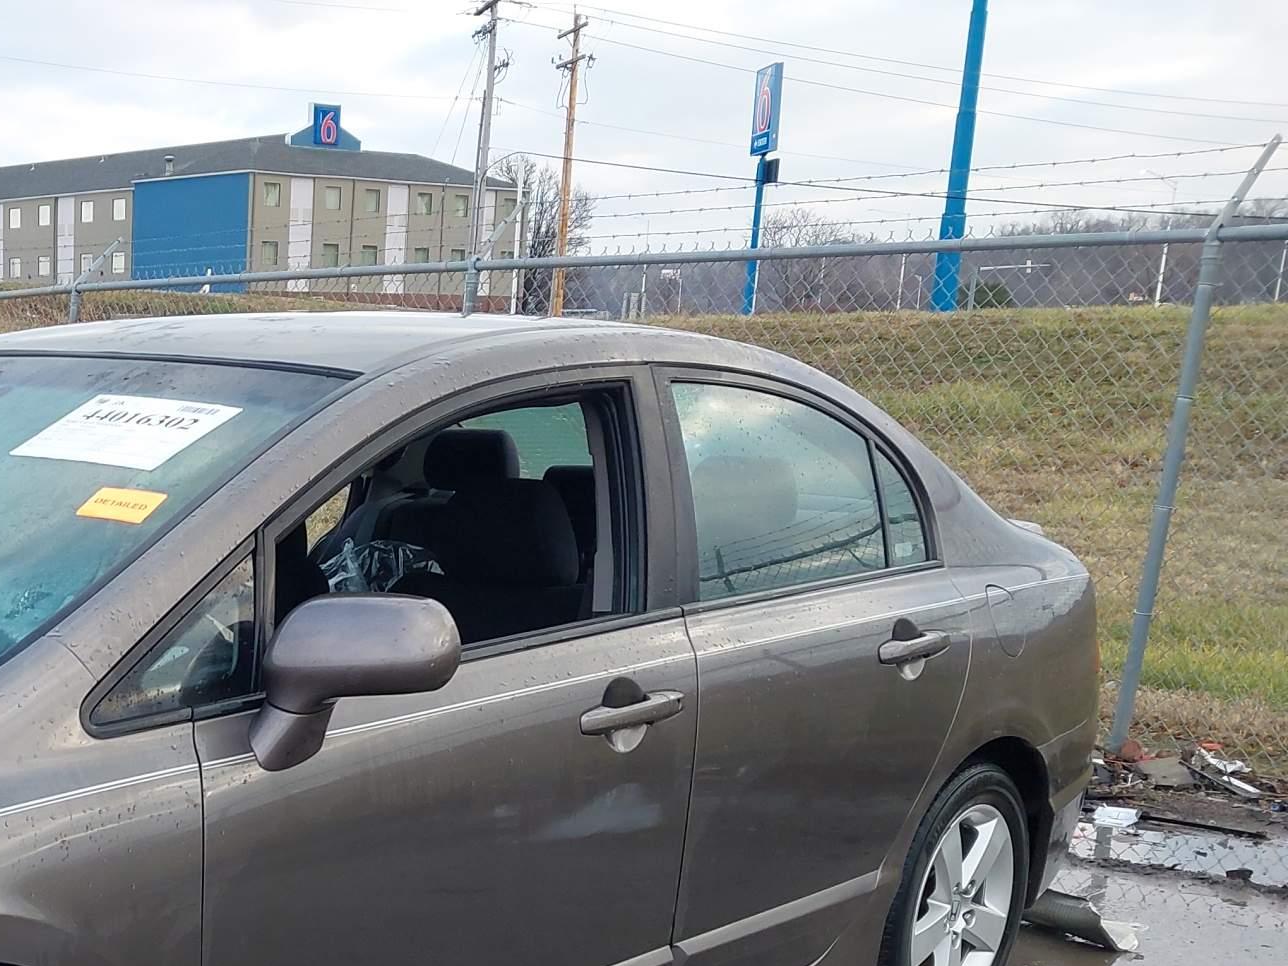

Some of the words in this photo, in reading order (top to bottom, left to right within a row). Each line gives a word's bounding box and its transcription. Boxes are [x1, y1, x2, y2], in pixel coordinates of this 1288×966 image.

[757, 67, 771, 132] 6
[321, 111, 337, 145] 6
[82, 409, 200, 430] 44016302
[94, 497, 149, 511] DETAILED
